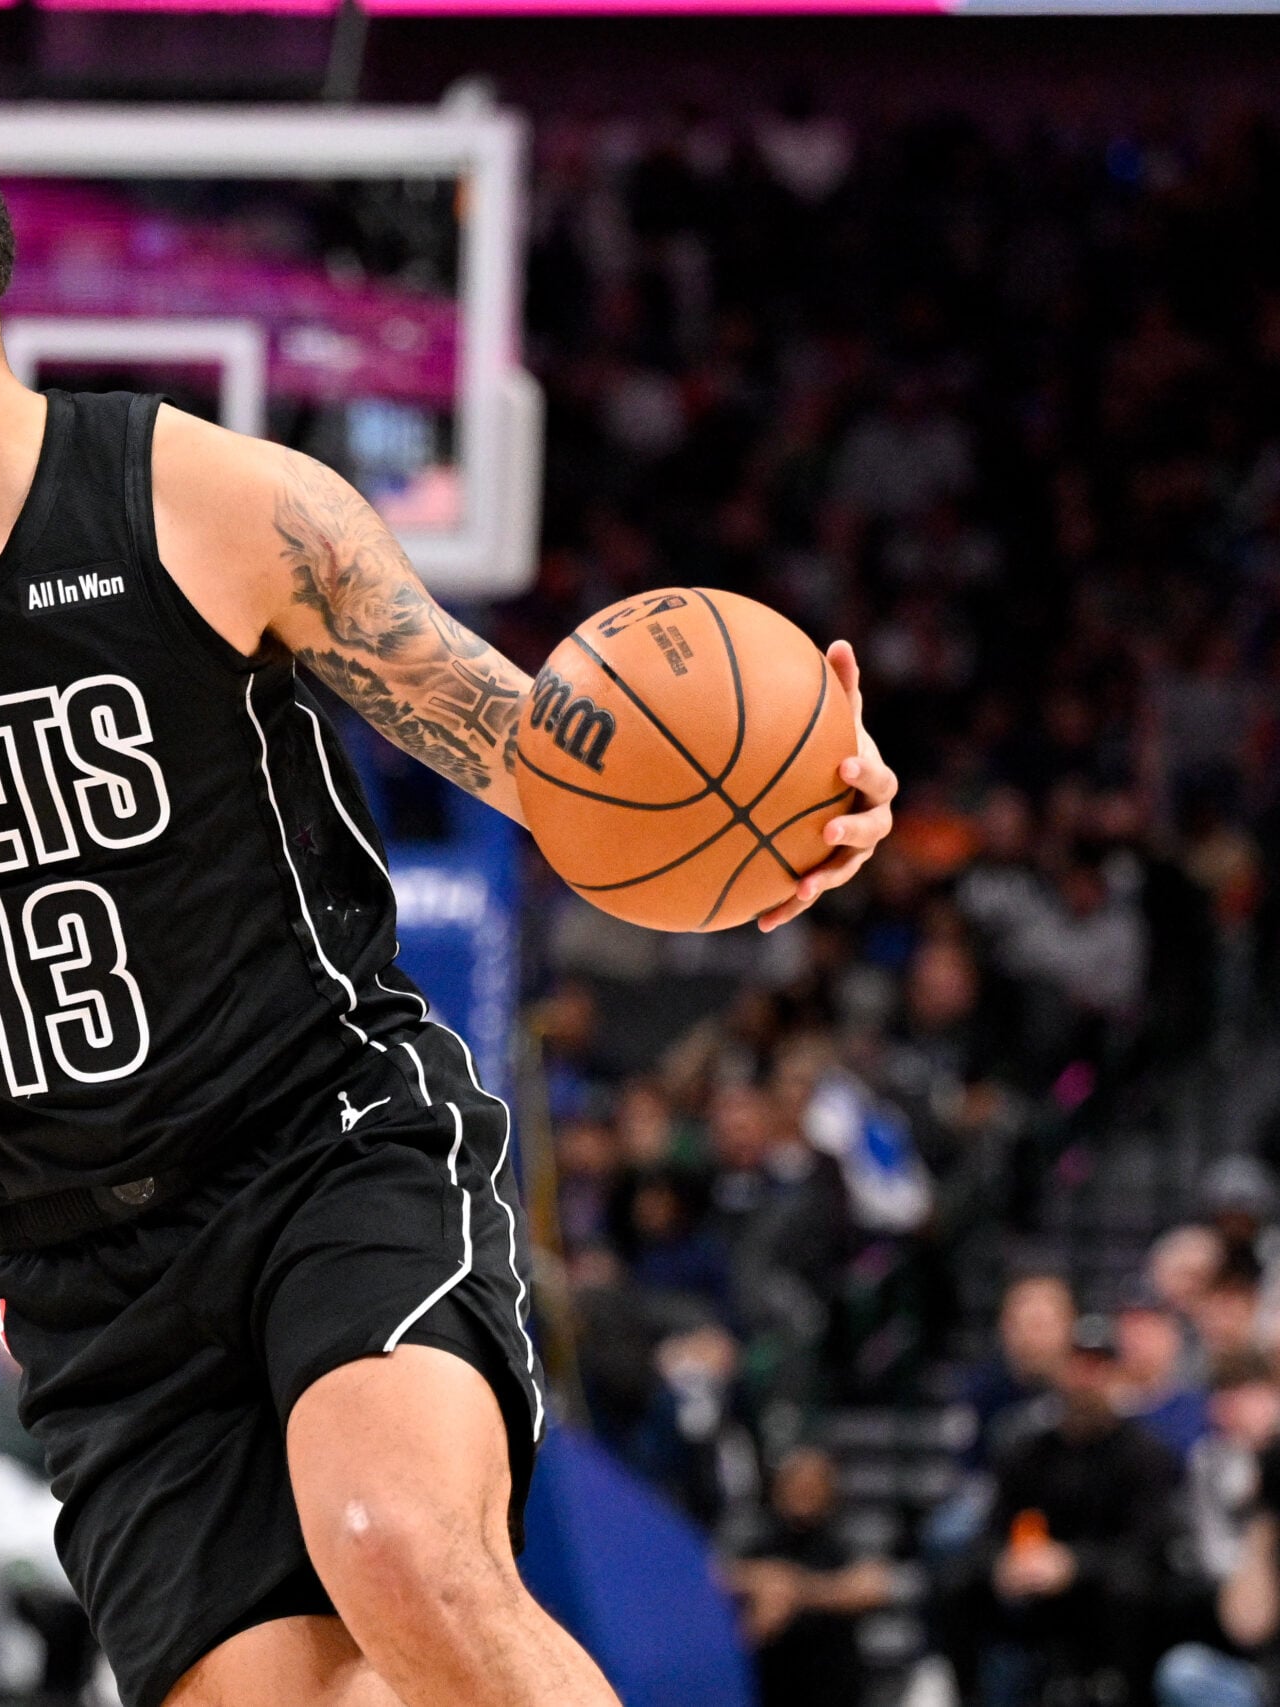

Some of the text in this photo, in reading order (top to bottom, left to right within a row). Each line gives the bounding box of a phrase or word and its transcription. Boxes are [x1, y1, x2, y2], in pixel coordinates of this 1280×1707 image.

[29, 572, 125, 610] All In Won
